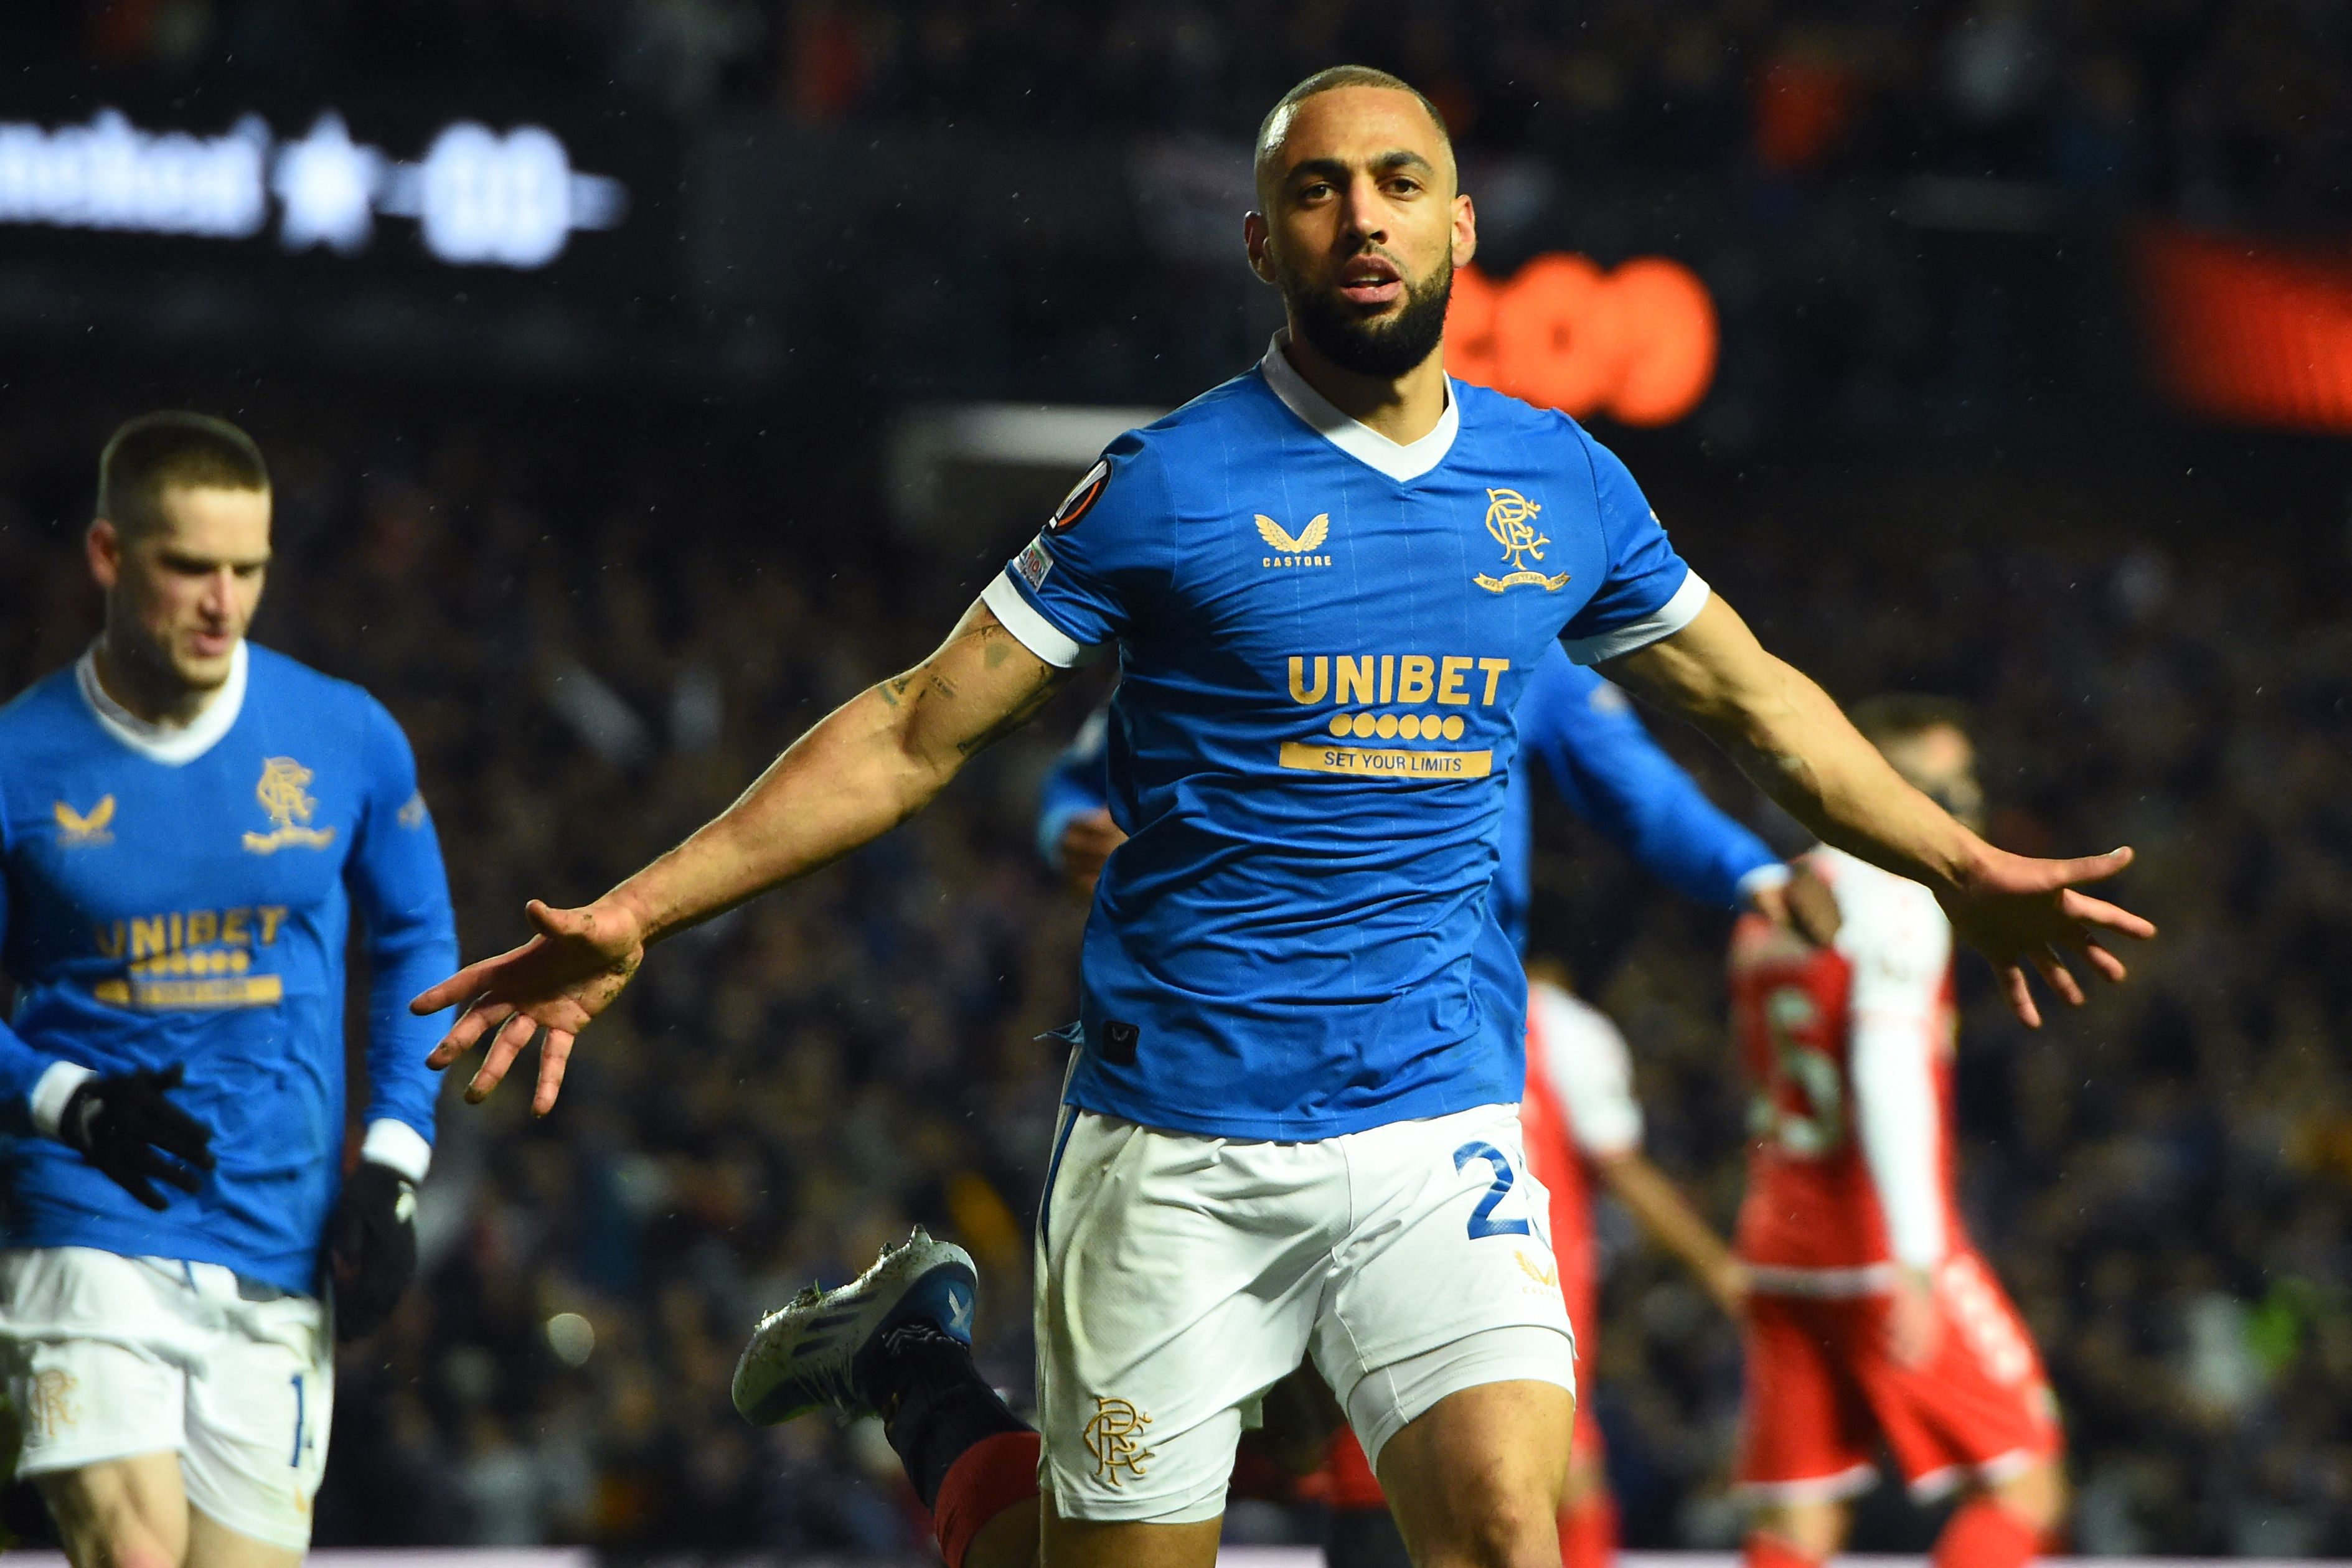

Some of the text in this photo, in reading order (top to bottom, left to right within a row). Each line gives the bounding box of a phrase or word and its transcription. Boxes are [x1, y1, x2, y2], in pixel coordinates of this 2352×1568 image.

[1263, 555, 1332, 568] CASTORE
[1288, 655, 1510, 706] UNIBET
[1324, 751, 1462, 772] SET YOUR LIMITS
[95, 905, 288, 959] UNIBET
[1452, 1140, 1531, 1241] 2
